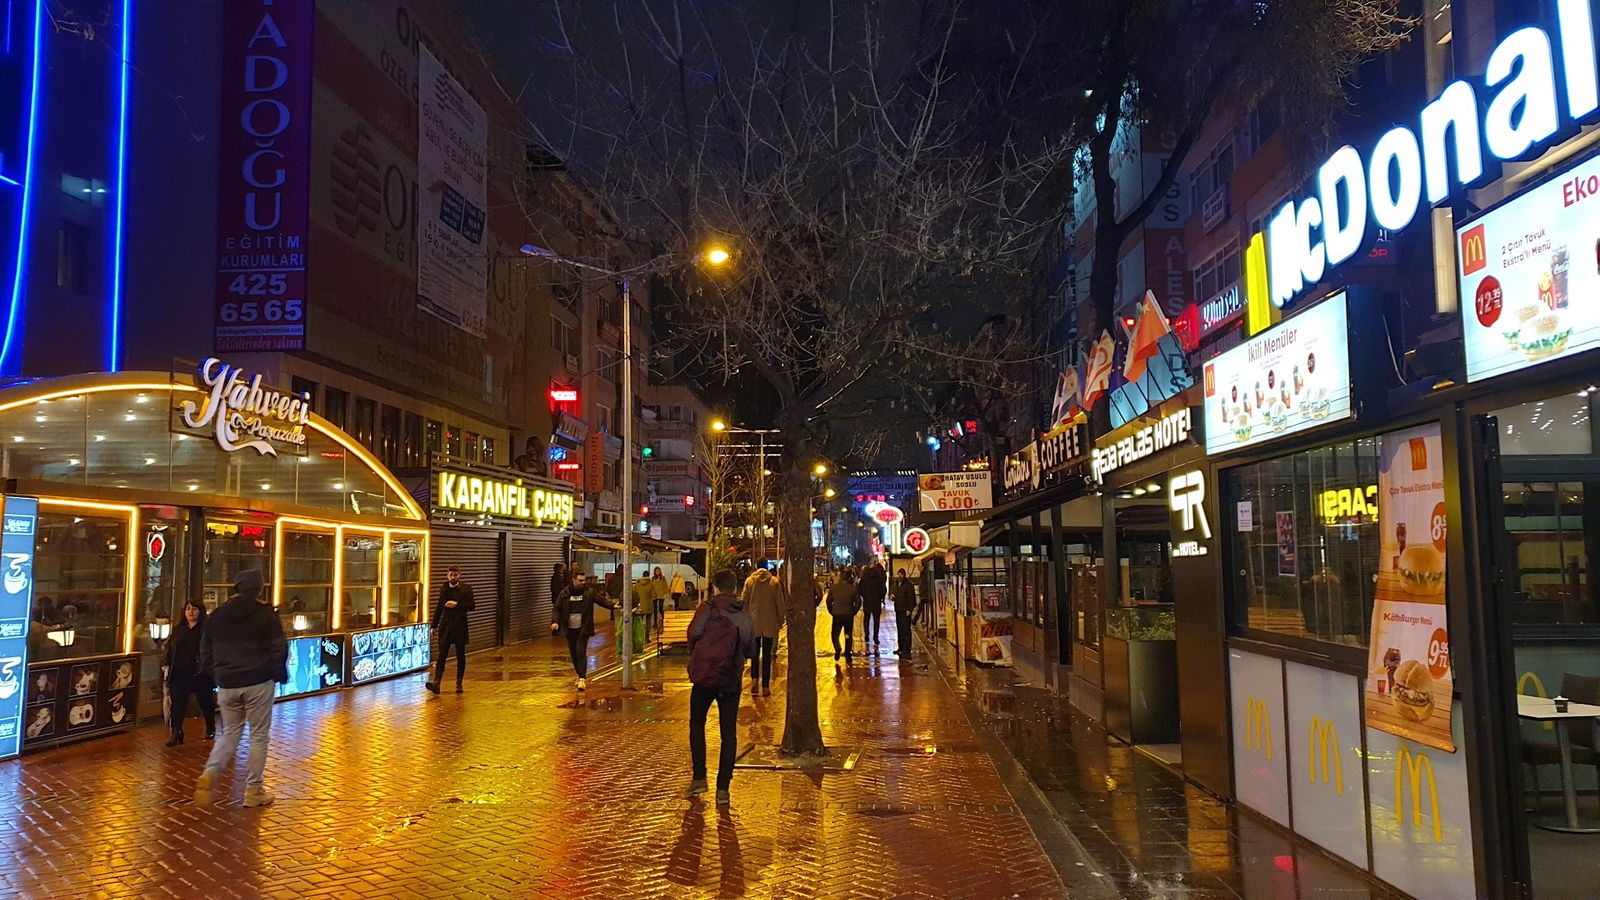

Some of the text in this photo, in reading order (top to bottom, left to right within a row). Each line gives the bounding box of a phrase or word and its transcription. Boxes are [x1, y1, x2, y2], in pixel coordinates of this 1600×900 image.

[240, 0, 291, 231] ADOĞU
[225, 232, 300, 249] EĞİTİM
[1525, 228, 1547, 243] Tavuk
[221, 253, 303, 267] KURUMLARI
[228, 273, 288, 296] 425
[220, 299, 303, 323] 65 65
[1264, 328, 1298, 356] Menüler
[1041, 424, 1080, 470] COFFEE
[439, 472, 574, 528] KARANFİL ÇARŞI
